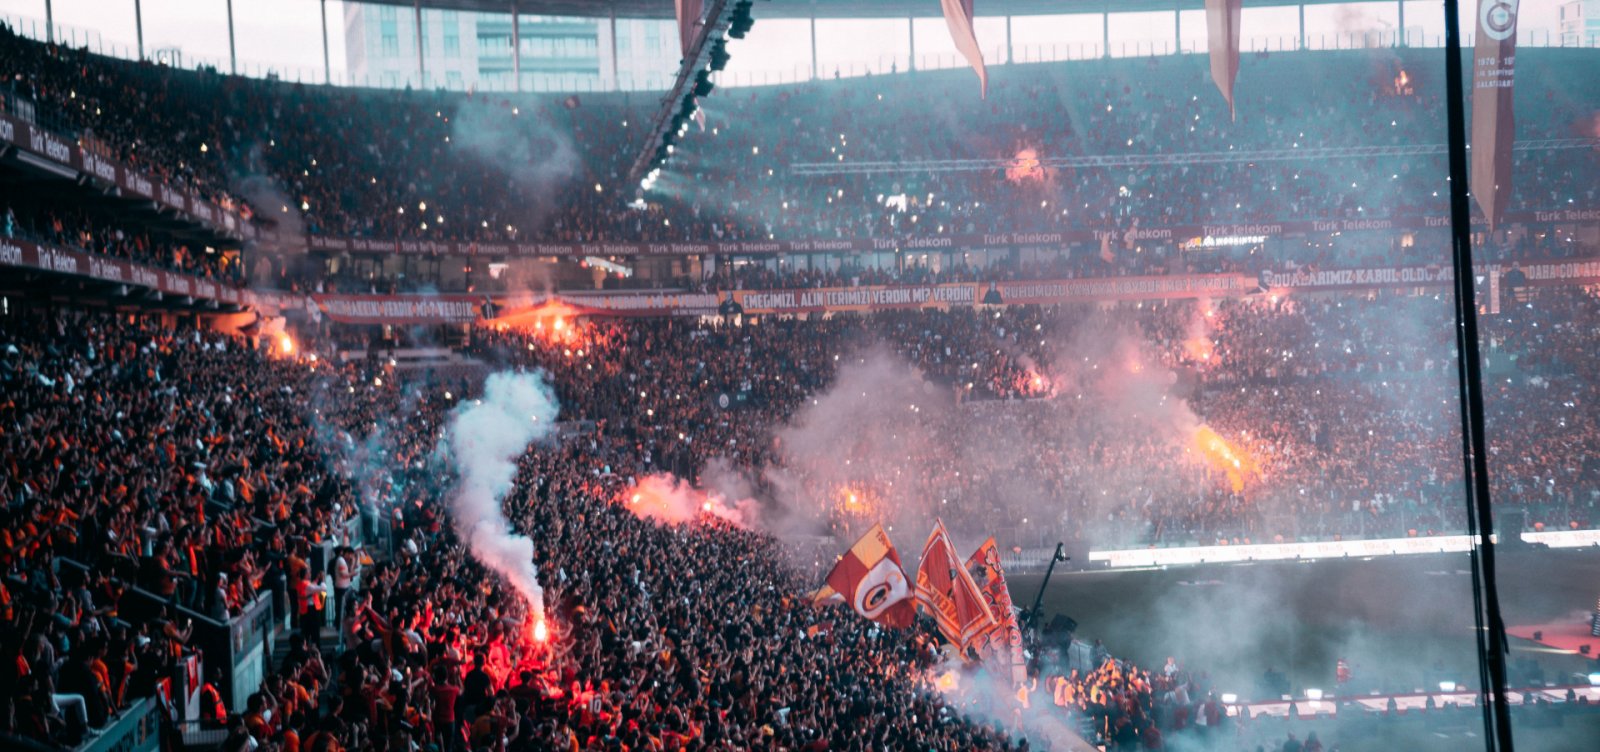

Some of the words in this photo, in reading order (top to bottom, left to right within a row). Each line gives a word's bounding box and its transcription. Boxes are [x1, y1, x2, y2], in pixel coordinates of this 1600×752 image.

[30, 126, 44, 154] Türk
[45, 131, 70, 163] Telekom
[1424, 216, 1449, 227] Türk
[1536, 211, 1561, 222] Türk
[1202, 225, 1229, 237] Türk
[1232, 223, 1282, 236] Telekom
[1312, 219, 1338, 231] Türk
[1341, 218, 1392, 231] Telekom
[873, 237, 898, 249] Türk
[984, 234, 1008, 245] Türk
[1012, 232, 1061, 244] Telekom
[518, 244, 536, 254] Türk
[538, 244, 572, 254] Telekom
[582, 244, 601, 254] Türk
[603, 244, 639, 254] Telekom
[649, 244, 668, 254] Türk
[671, 244, 708, 254] Telekom
[719, 243, 737, 253] Türk
[741, 243, 779, 253] Telekom
[789, 241, 809, 251] Türk
[813, 240, 852, 251] Telekom
[37, 245, 51, 270] Türk
[52, 248, 77, 274] Telekom
[1356, 268, 1398, 284] KABUL
[1528, 264, 1556, 280] DAHA
[802, 290, 827, 307] ALIN
[872, 286, 916, 304] VERDİK
